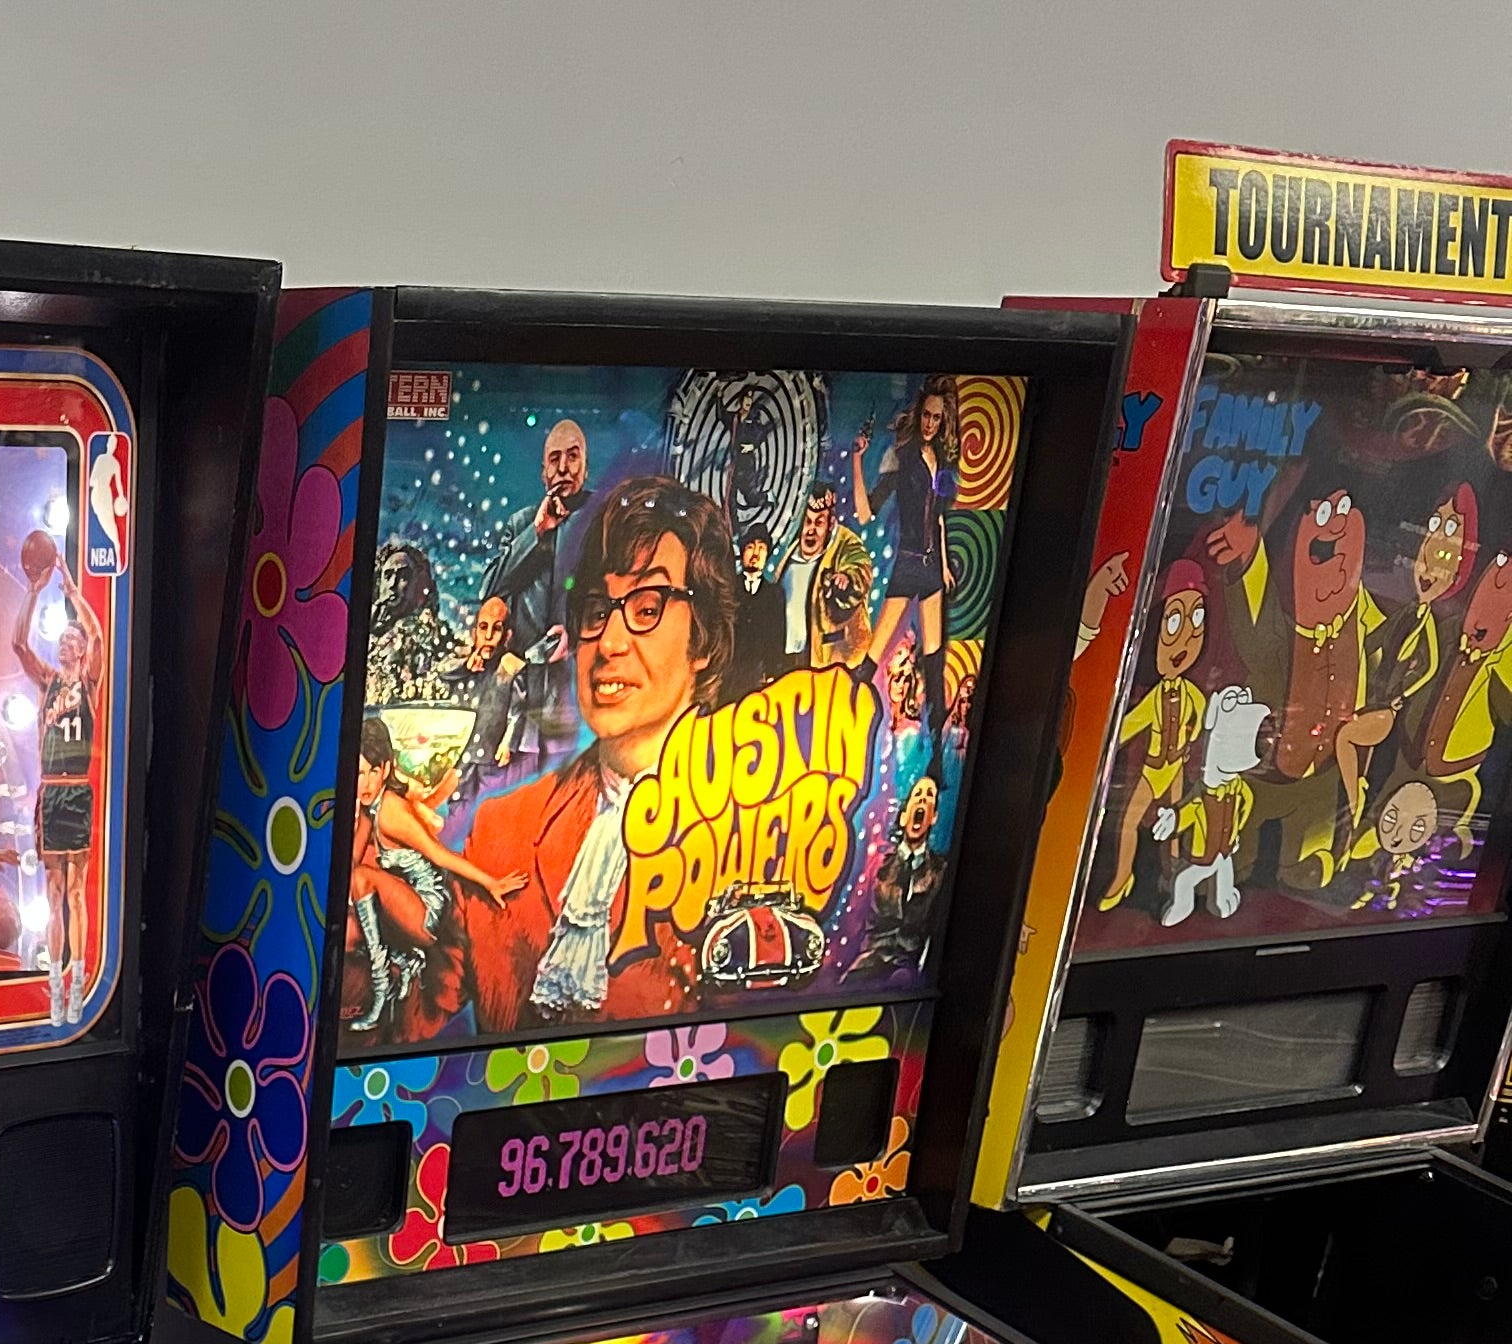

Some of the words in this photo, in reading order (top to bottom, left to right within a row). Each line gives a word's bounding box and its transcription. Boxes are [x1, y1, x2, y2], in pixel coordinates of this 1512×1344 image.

[1208, 167, 1512, 279] TOURNAMENT
[1186, 455, 1277, 516] GUY
[90, 547, 115, 567] NBA
[59, 717, 82, 742] 11
[625, 666, 877, 855] AUSTIN
[608, 773, 859, 966] POWERS
